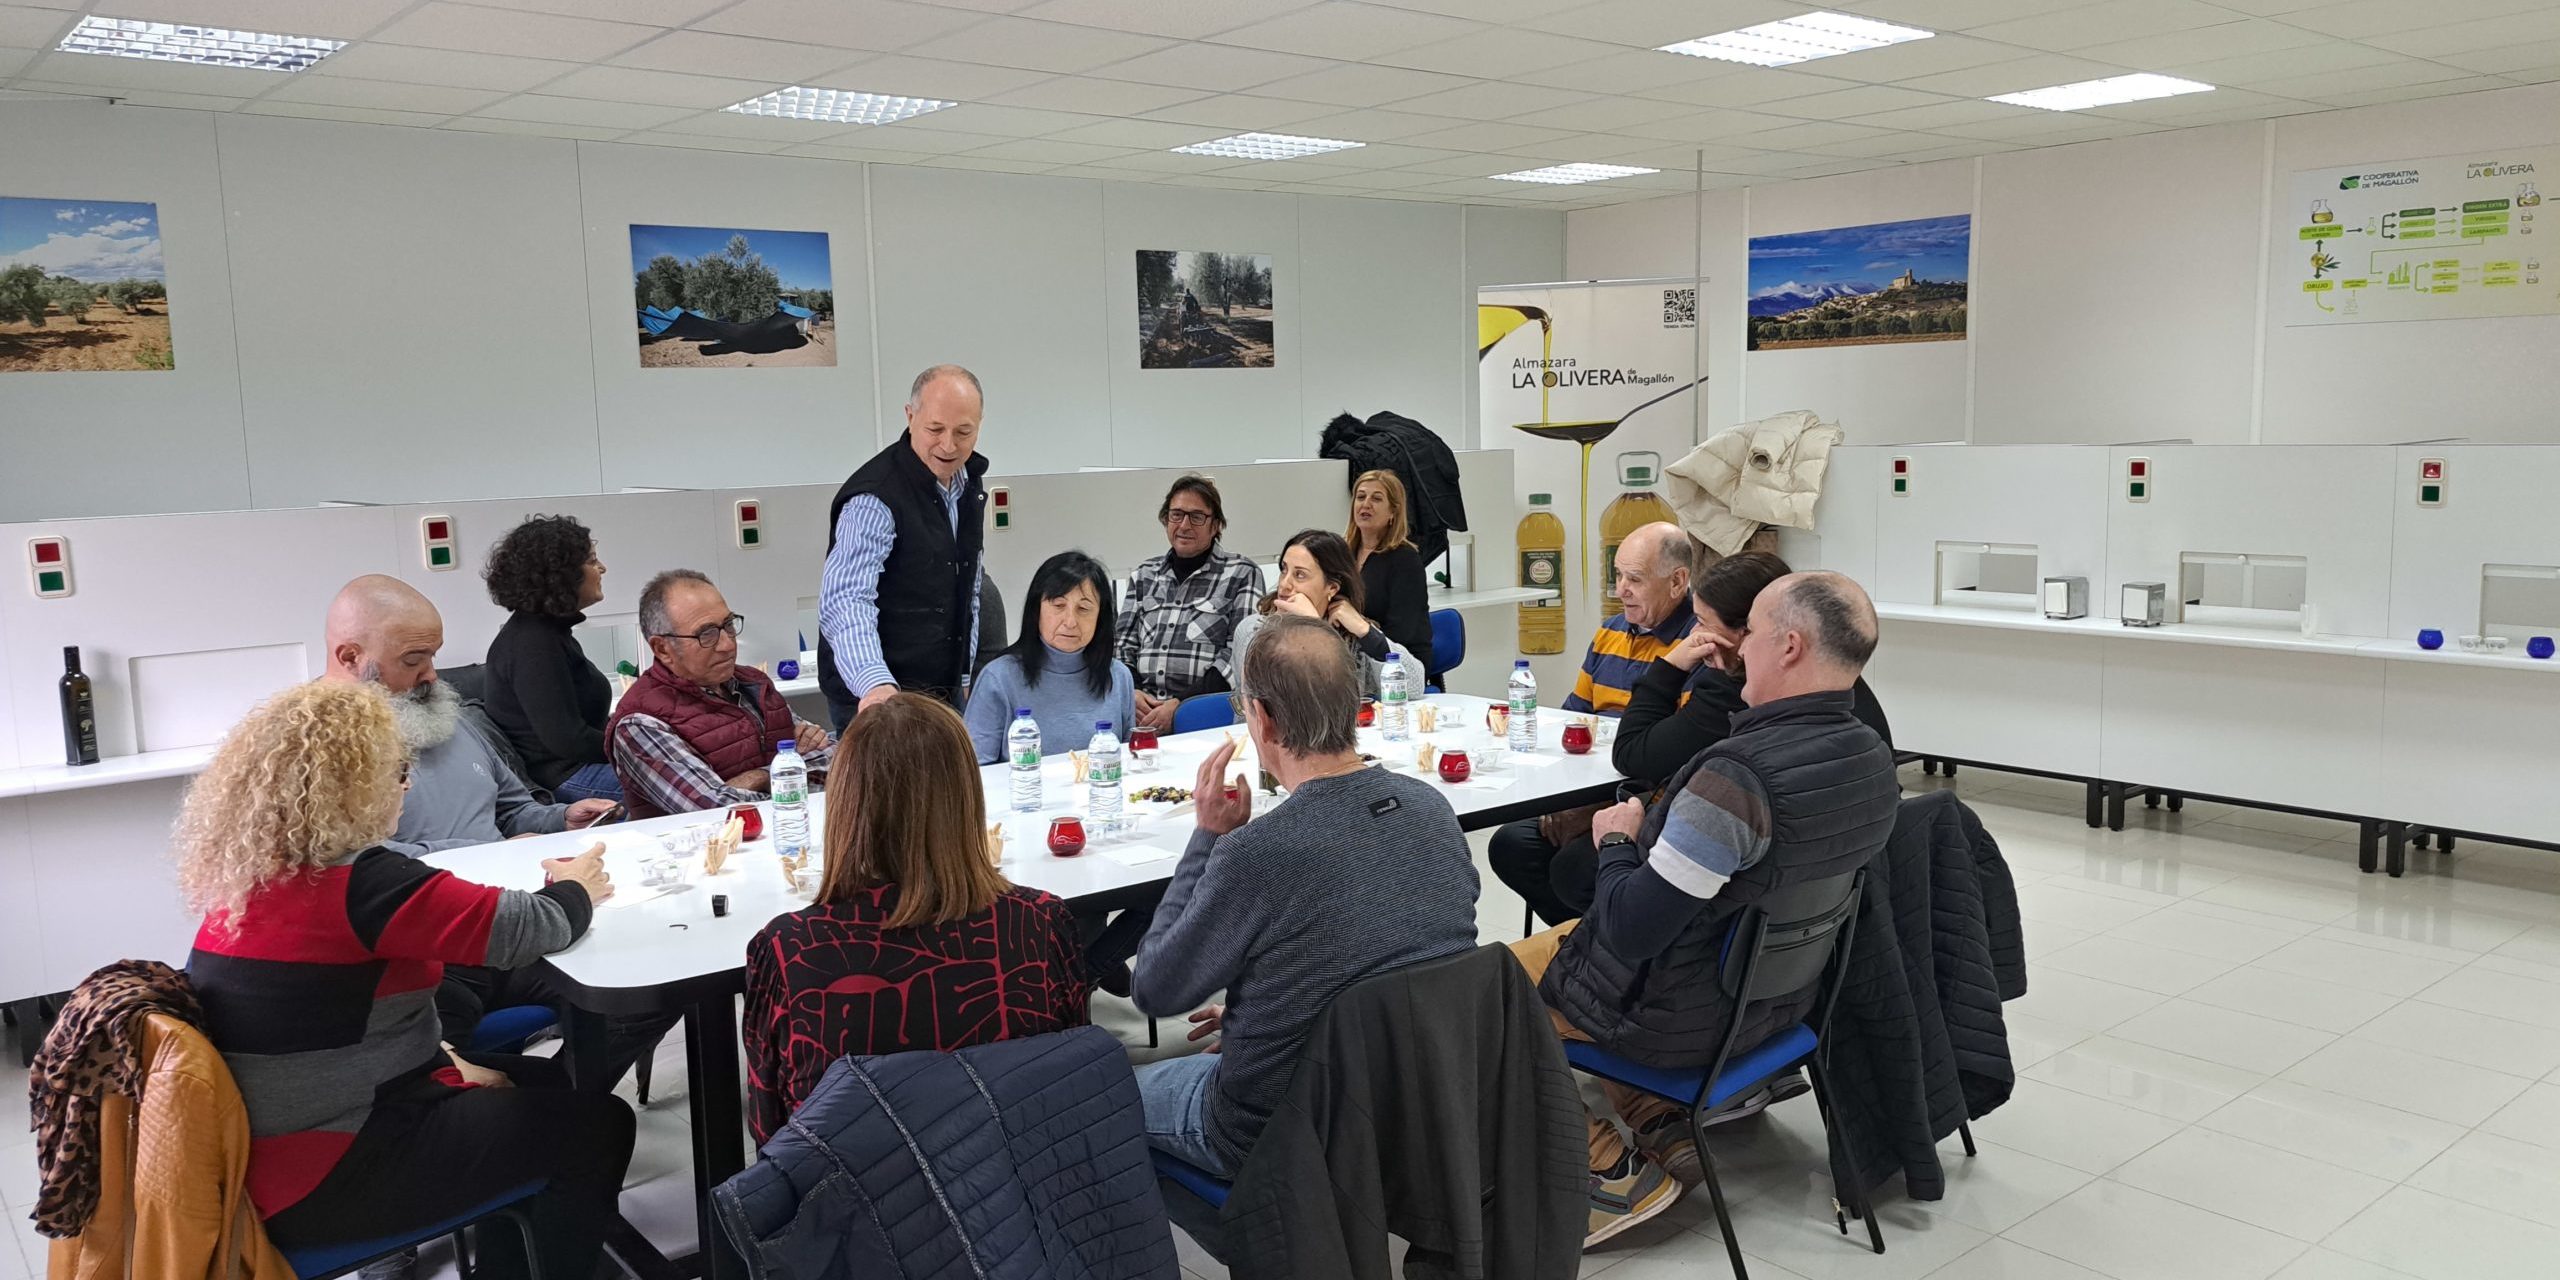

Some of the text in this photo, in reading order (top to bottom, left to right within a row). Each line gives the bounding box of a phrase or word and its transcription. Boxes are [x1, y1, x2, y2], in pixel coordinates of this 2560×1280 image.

[2363, 169, 2419, 181] COOPERATIVA
[2467, 163, 2535, 179] LA OLIVERA
[2373, 176, 2419, 188] MAGALLÓN
[1513, 357, 1577, 369] Almazara
[1513, 369, 1625, 389] LA OLIVERA
[1628, 374, 1675, 386] Magallón
